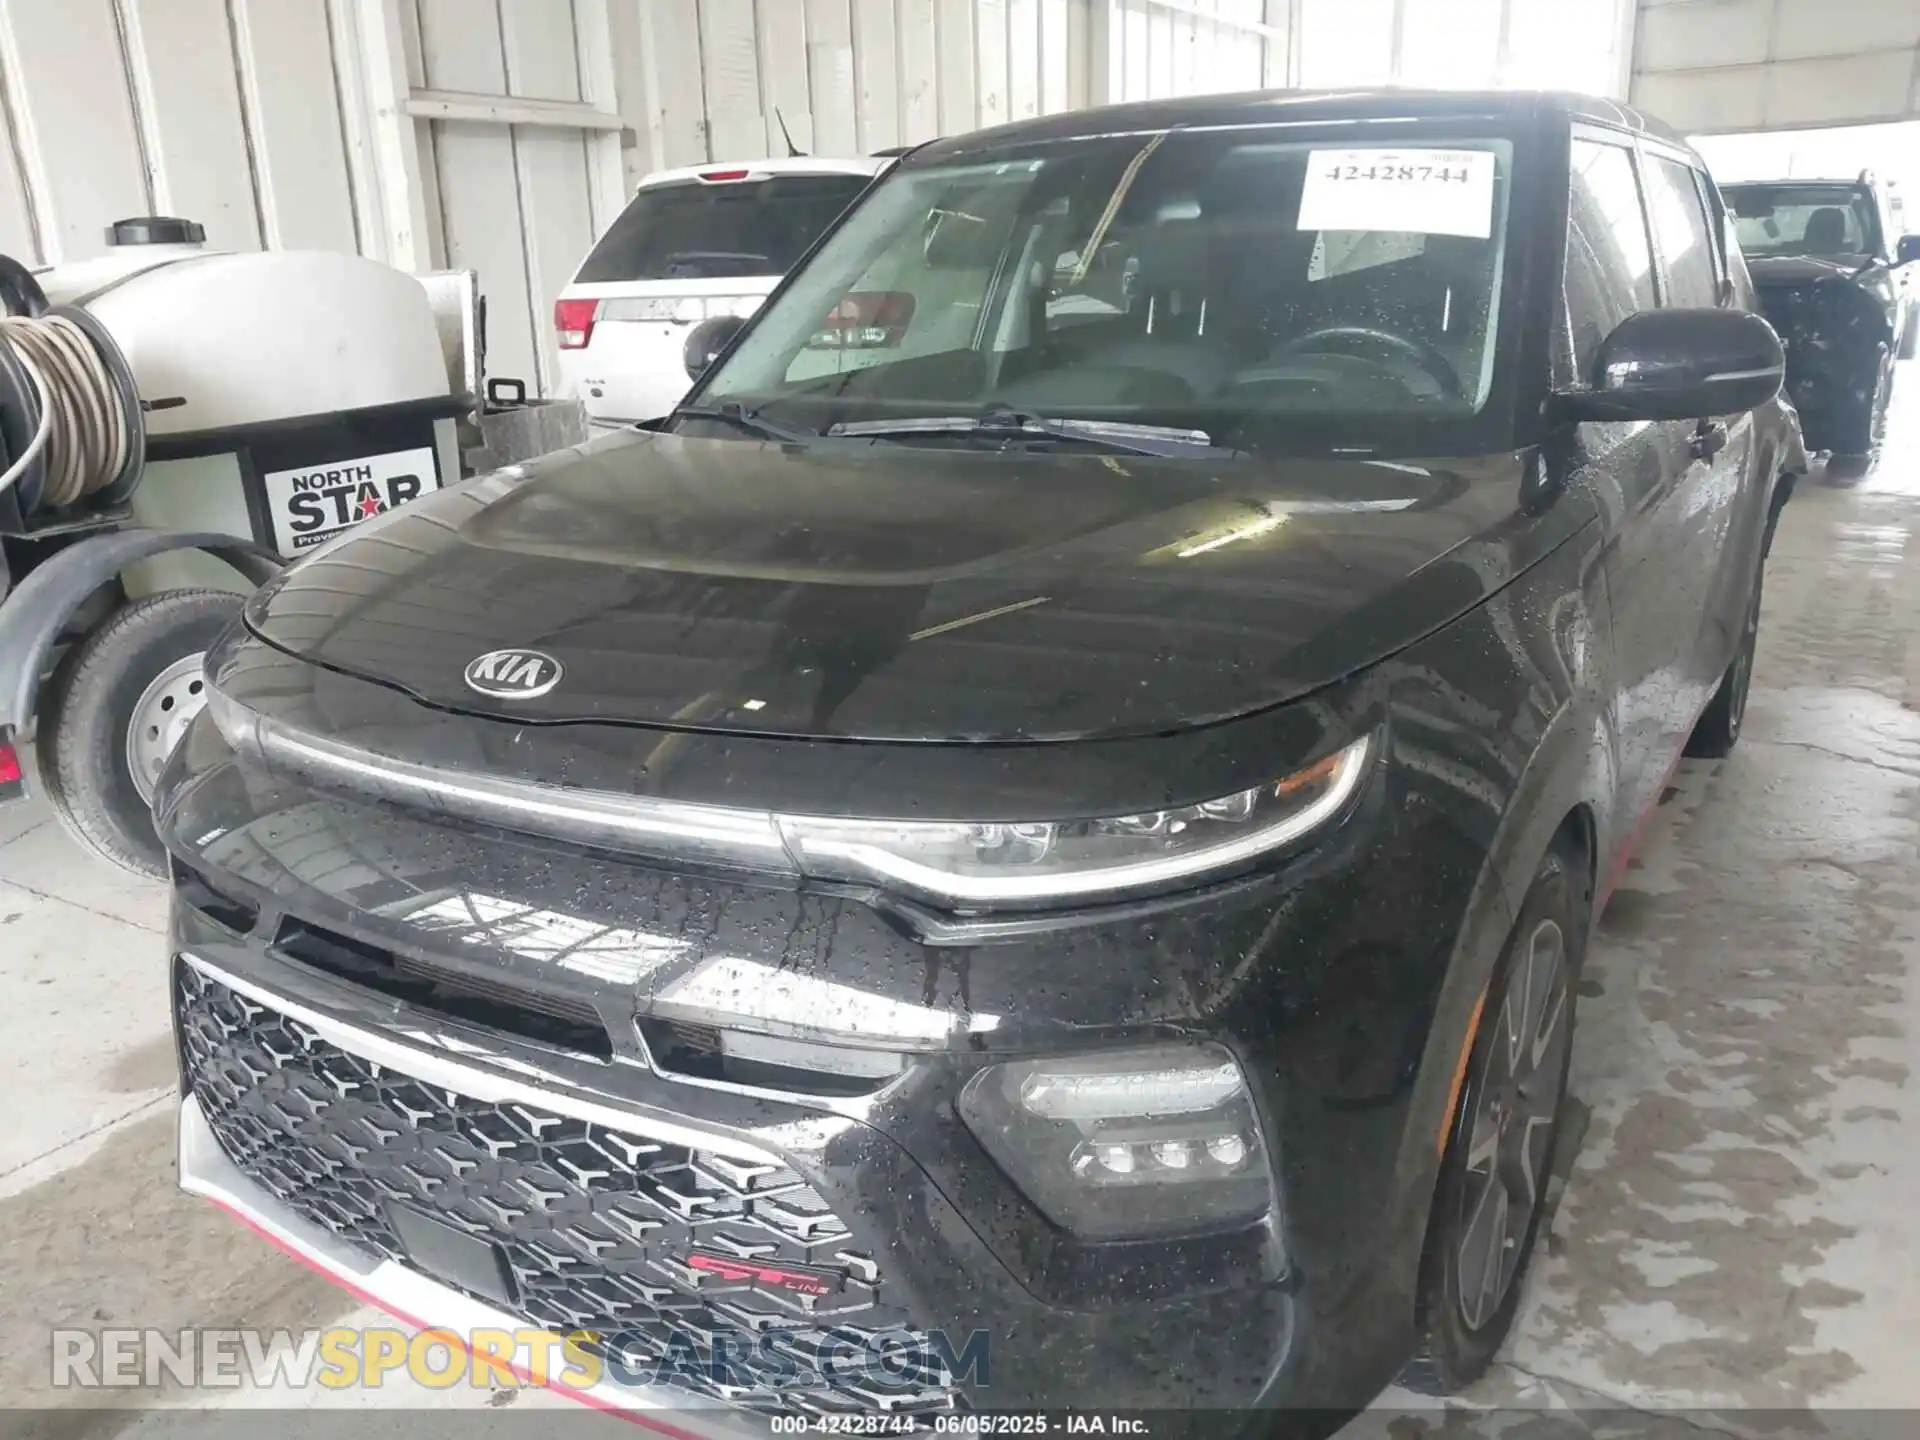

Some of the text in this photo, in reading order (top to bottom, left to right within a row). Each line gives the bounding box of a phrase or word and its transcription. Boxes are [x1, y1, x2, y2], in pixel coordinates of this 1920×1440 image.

[1325, 165, 1469, 183] 42428744
[292, 464, 372, 493] NORTH
[287, 474, 421, 532] STAR
[472, 654, 543, 688] KIA
[784, 1281, 830, 1293] LINE
